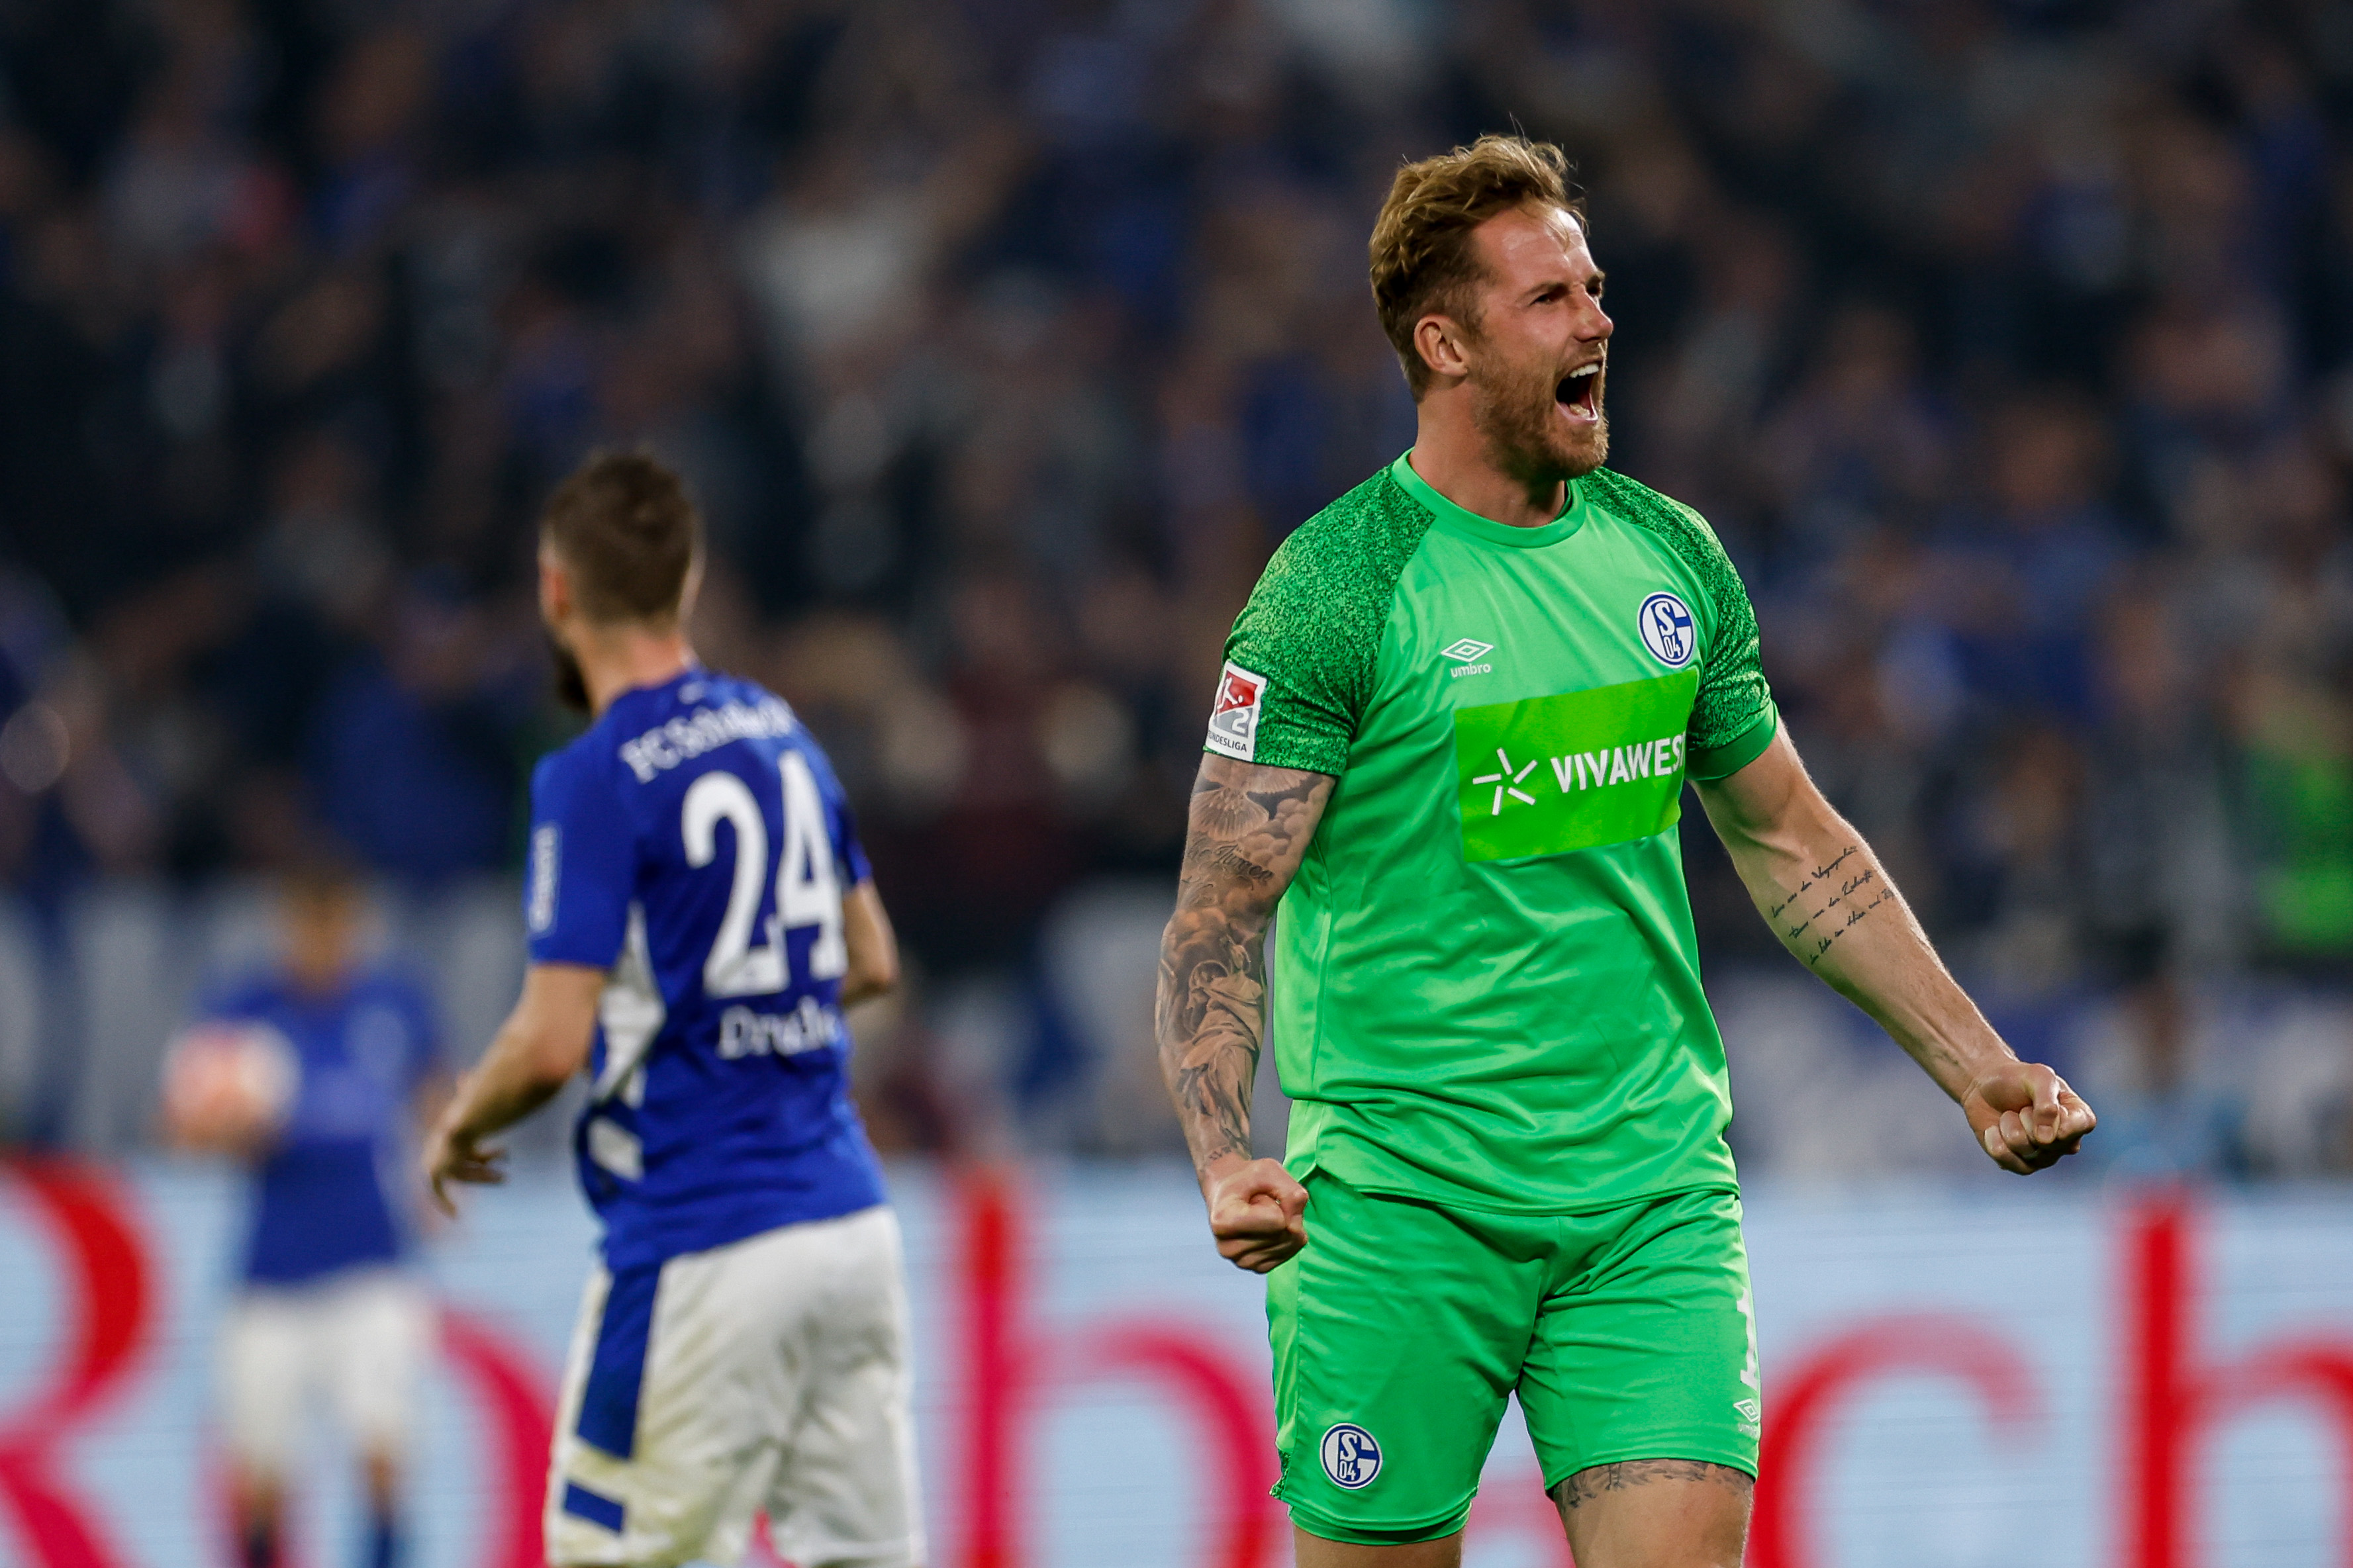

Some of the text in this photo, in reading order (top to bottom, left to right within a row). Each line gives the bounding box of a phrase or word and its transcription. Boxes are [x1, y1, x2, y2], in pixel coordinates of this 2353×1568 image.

[1450, 663, 1491, 678] umbro
[1231, 707, 1250, 734] 2
[681, 750, 849, 999] 24
